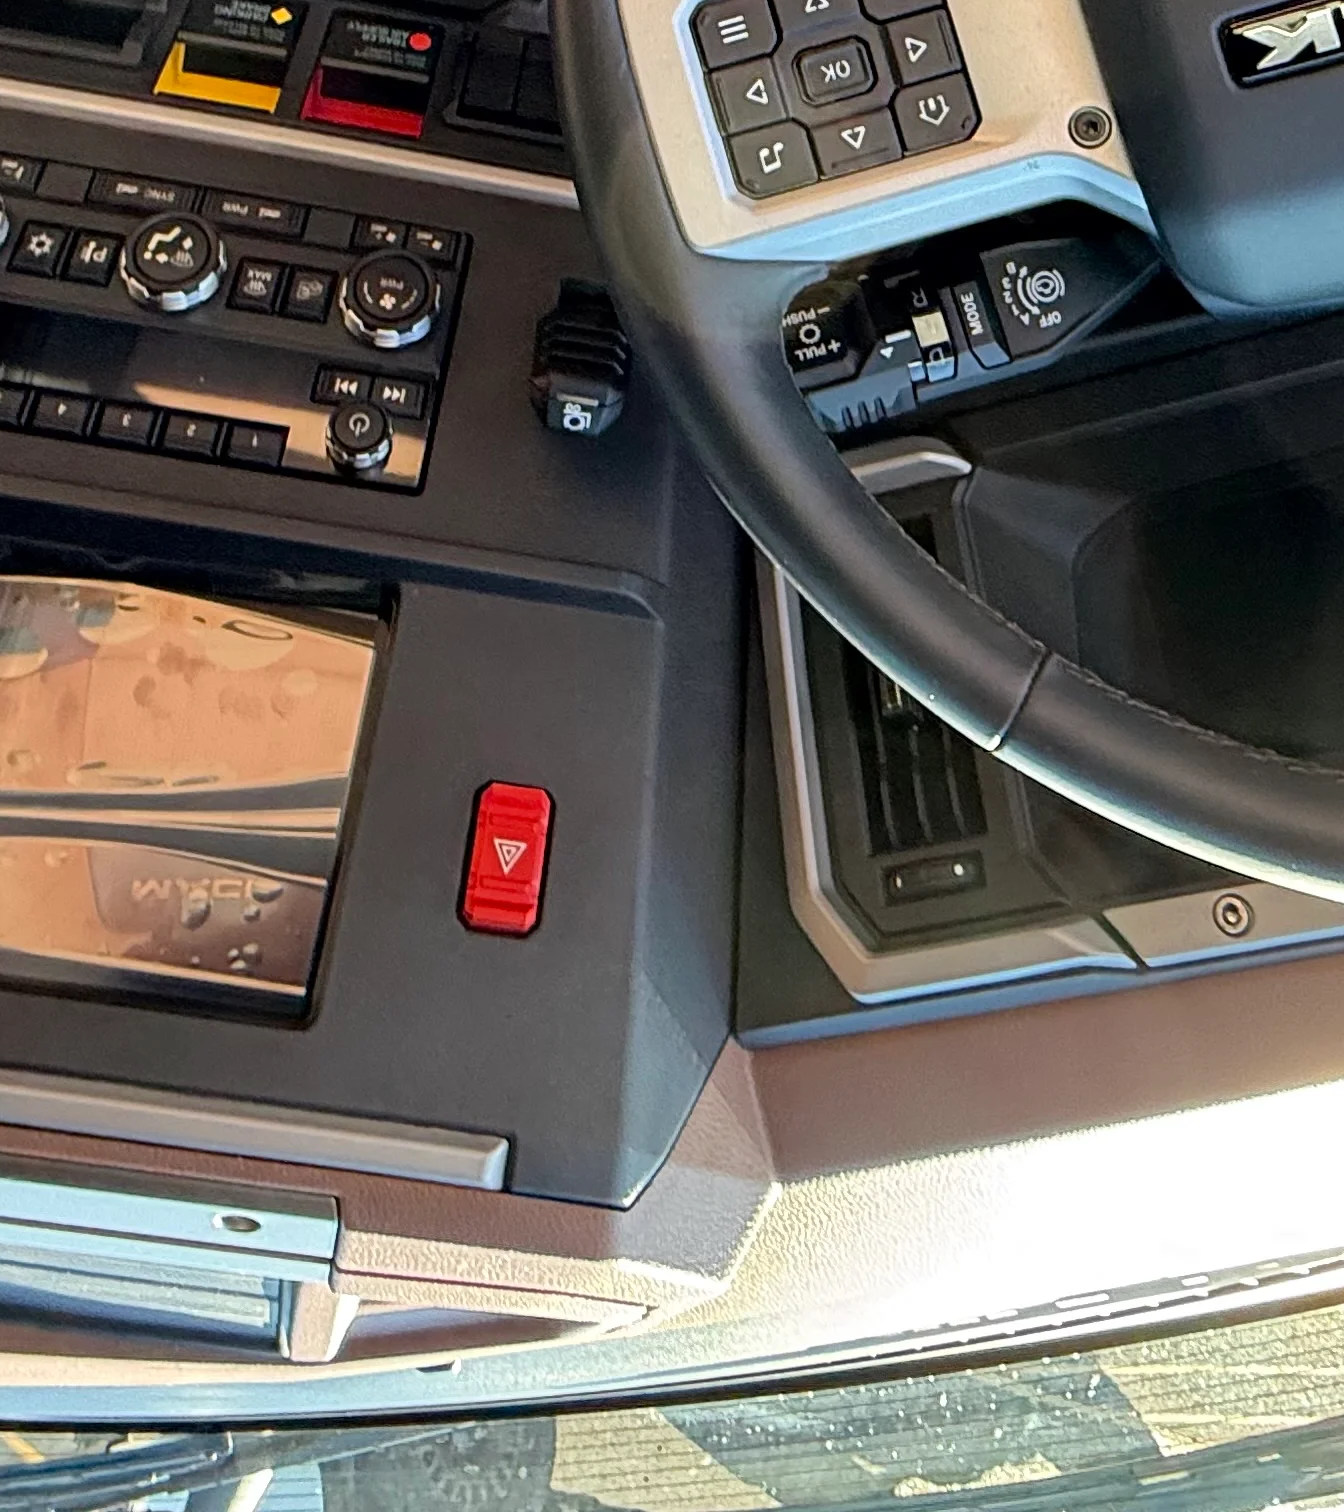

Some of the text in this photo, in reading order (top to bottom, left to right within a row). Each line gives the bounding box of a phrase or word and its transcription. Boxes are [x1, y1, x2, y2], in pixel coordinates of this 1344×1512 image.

[819, 60, 851, 83] OK
[222, 200, 249, 217] PWR
[247, 267, 273, 282] MAX
[380, 277, 404, 290] PWR
[1001, 277, 1011, 290] 3
[911, 287, 928, 308] R
[1002, 290, 1013, 303] 2
[781, 307, 816, 327] PUSH
[960, 291, 984, 336] MODE
[1019, 312, 1030, 326] A
[1038, 310, 1062, 328] OFF
[794, 343, 827, 362] PULL
[929, 347, 944, 364] D
[57, 403, 67, 416] 4
[122, 413, 132, 428] 3
